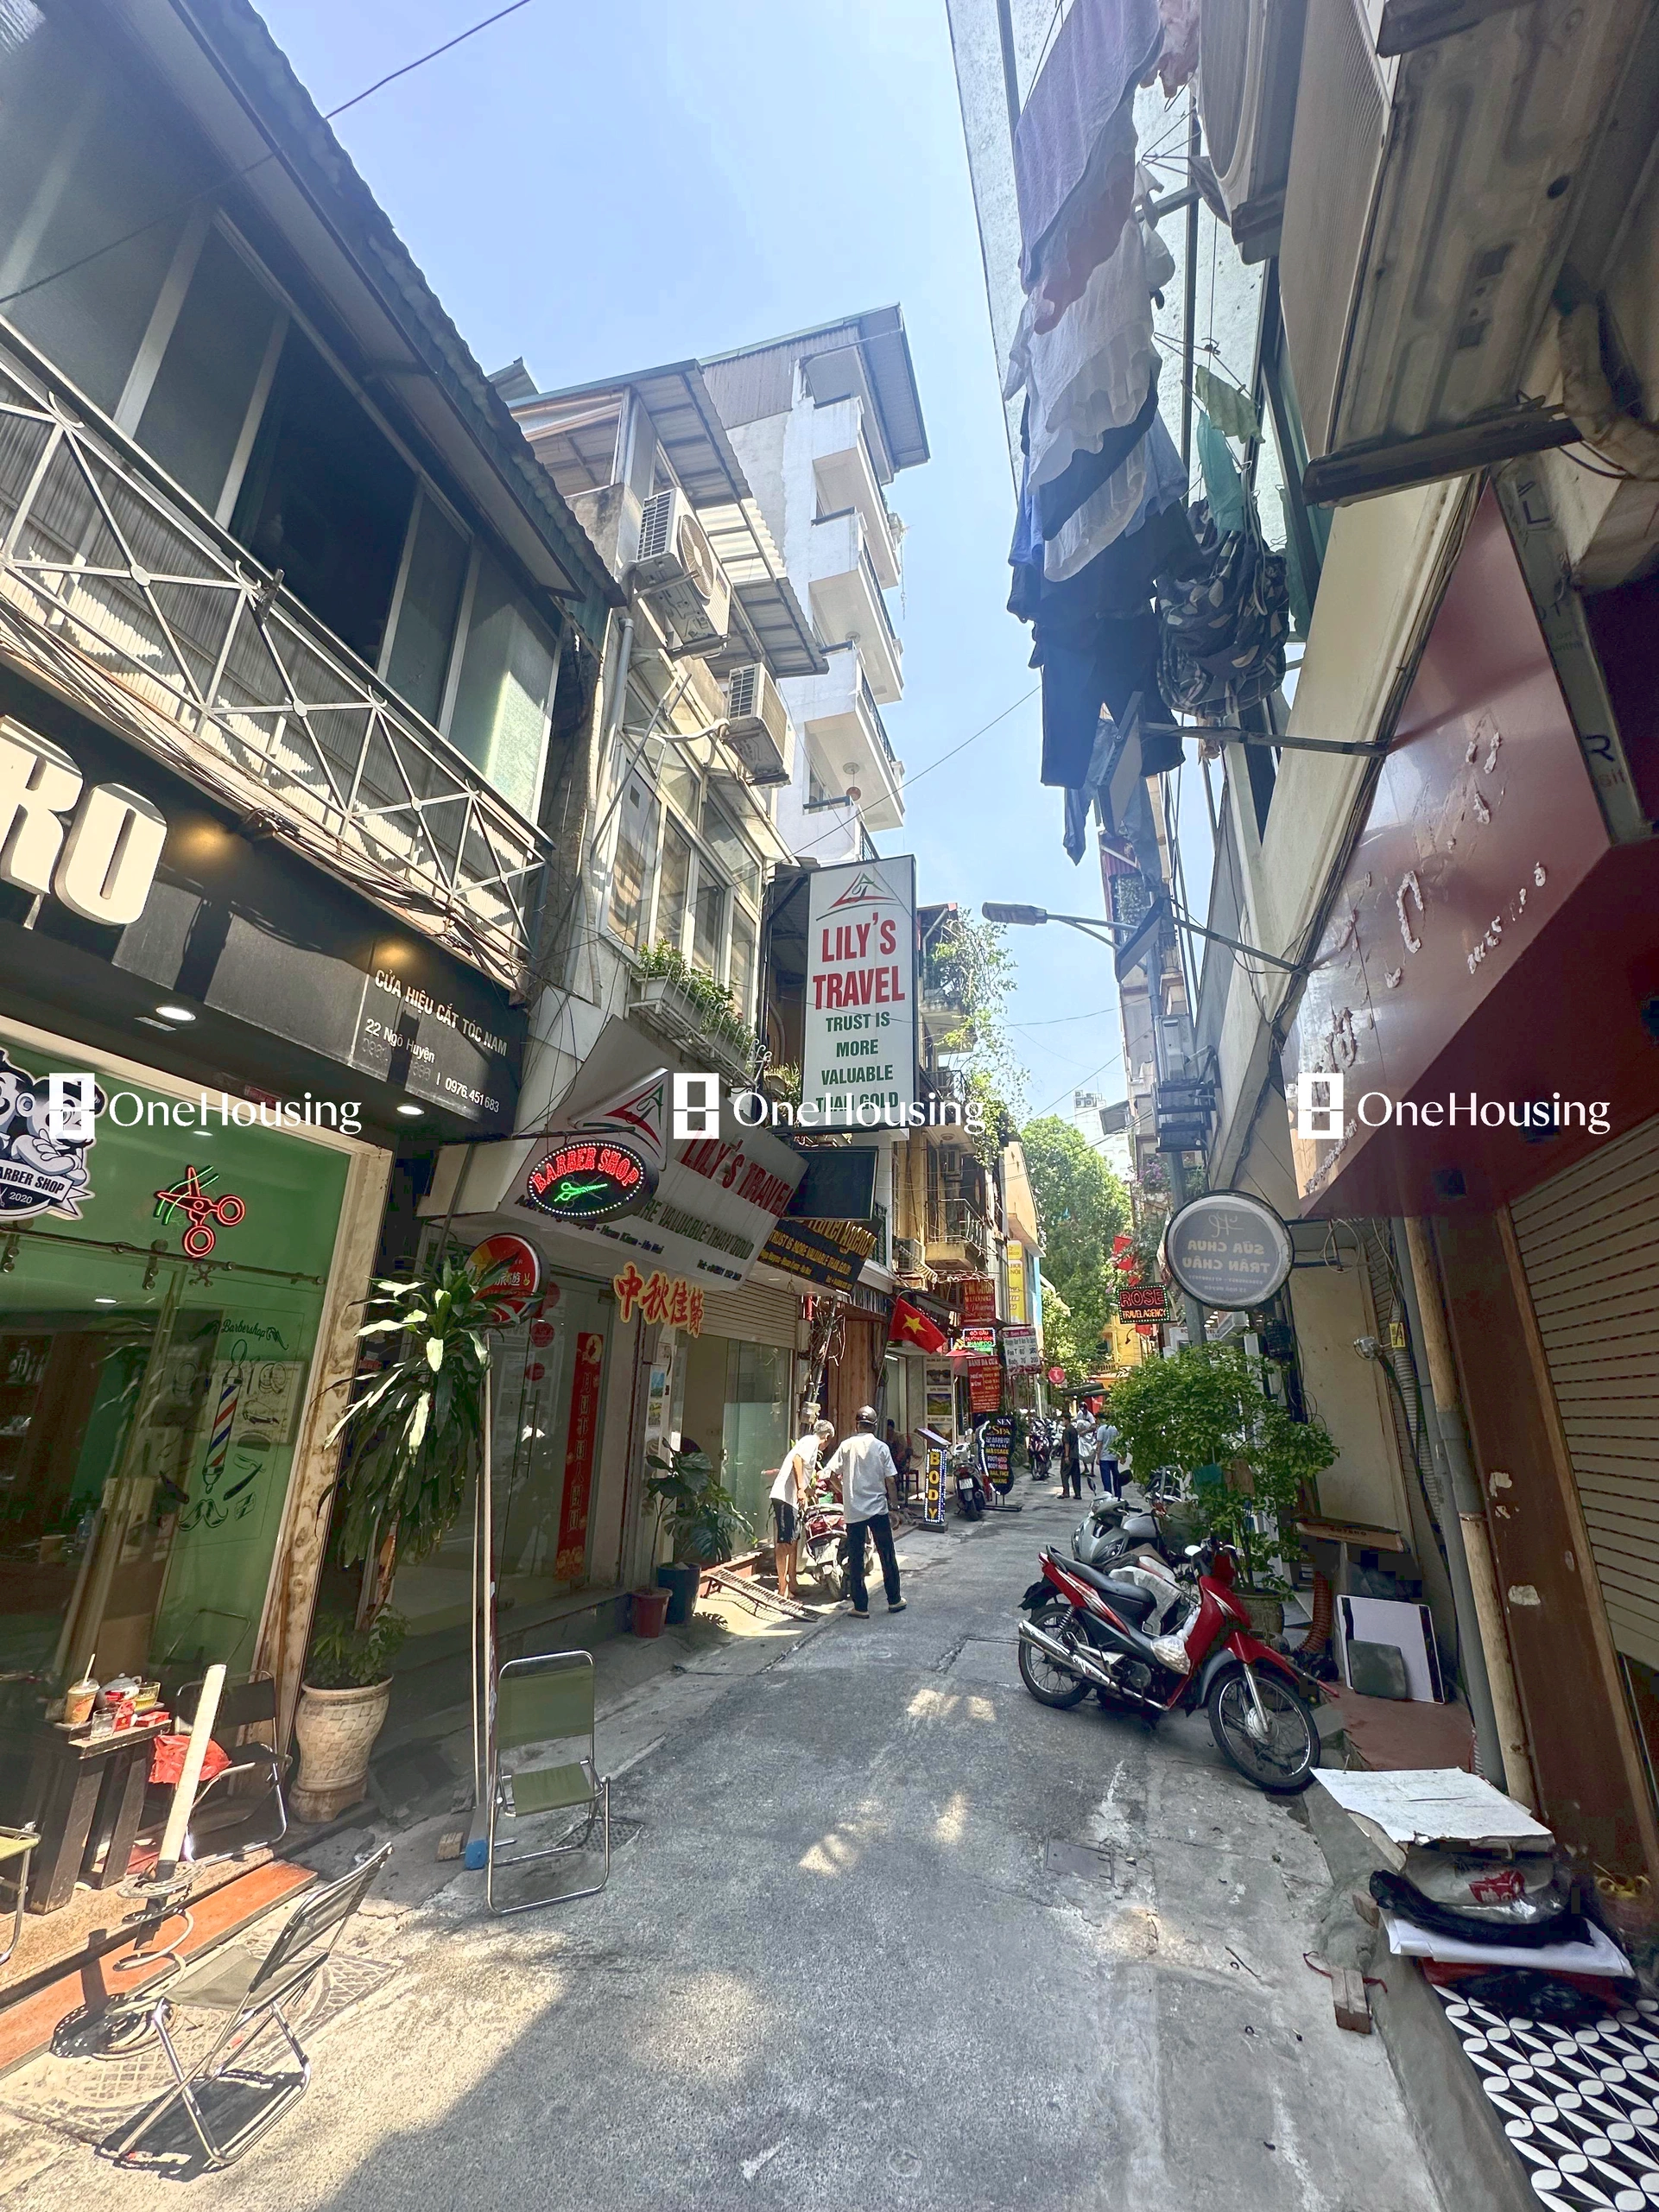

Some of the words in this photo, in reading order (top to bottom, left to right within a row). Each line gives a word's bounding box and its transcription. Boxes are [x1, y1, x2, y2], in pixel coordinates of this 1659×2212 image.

[820, 912, 896, 963] LILY'S
[813, 965, 906, 1010] TRAVEL
[375, 969, 402, 998] CỬA
[404, 986, 434, 1015] HIỆU
[435, 1004, 459, 1029] CẮT
[462, 1020, 483, 1043] TÓC
[484, 1031, 508, 1056] NAM
[826, 1013, 871, 1032] TRUST
[874, 1011, 890, 1028] IS
[365, 1018, 382, 1036] 22
[406, 1041, 436, 1063] Huyện
[836, 1039, 879, 1058] MORE
[820, 1064, 894, 1087] VALUABLE
[681, 1127, 744, 1188] LILY'S
[532, 1148, 597, 1194] BARBER
[598, 1150, 639, 1187] SHOP
[35, 1176, 65, 1194] SHOP
[9, 1192, 33, 1204] 2020
[658, 1206, 711, 1242] VALUABLE
[1120, 1289, 1165, 1307] ROSE
[1122, 1309, 1143, 1319] TRAVEL
[1143, 1308, 1166, 1318] AGENCY
[221, 1319, 267, 1341] Barbershop
[992, 1425, 1011, 1435] SPA
[928, 1452, 940, 1520] BODY
